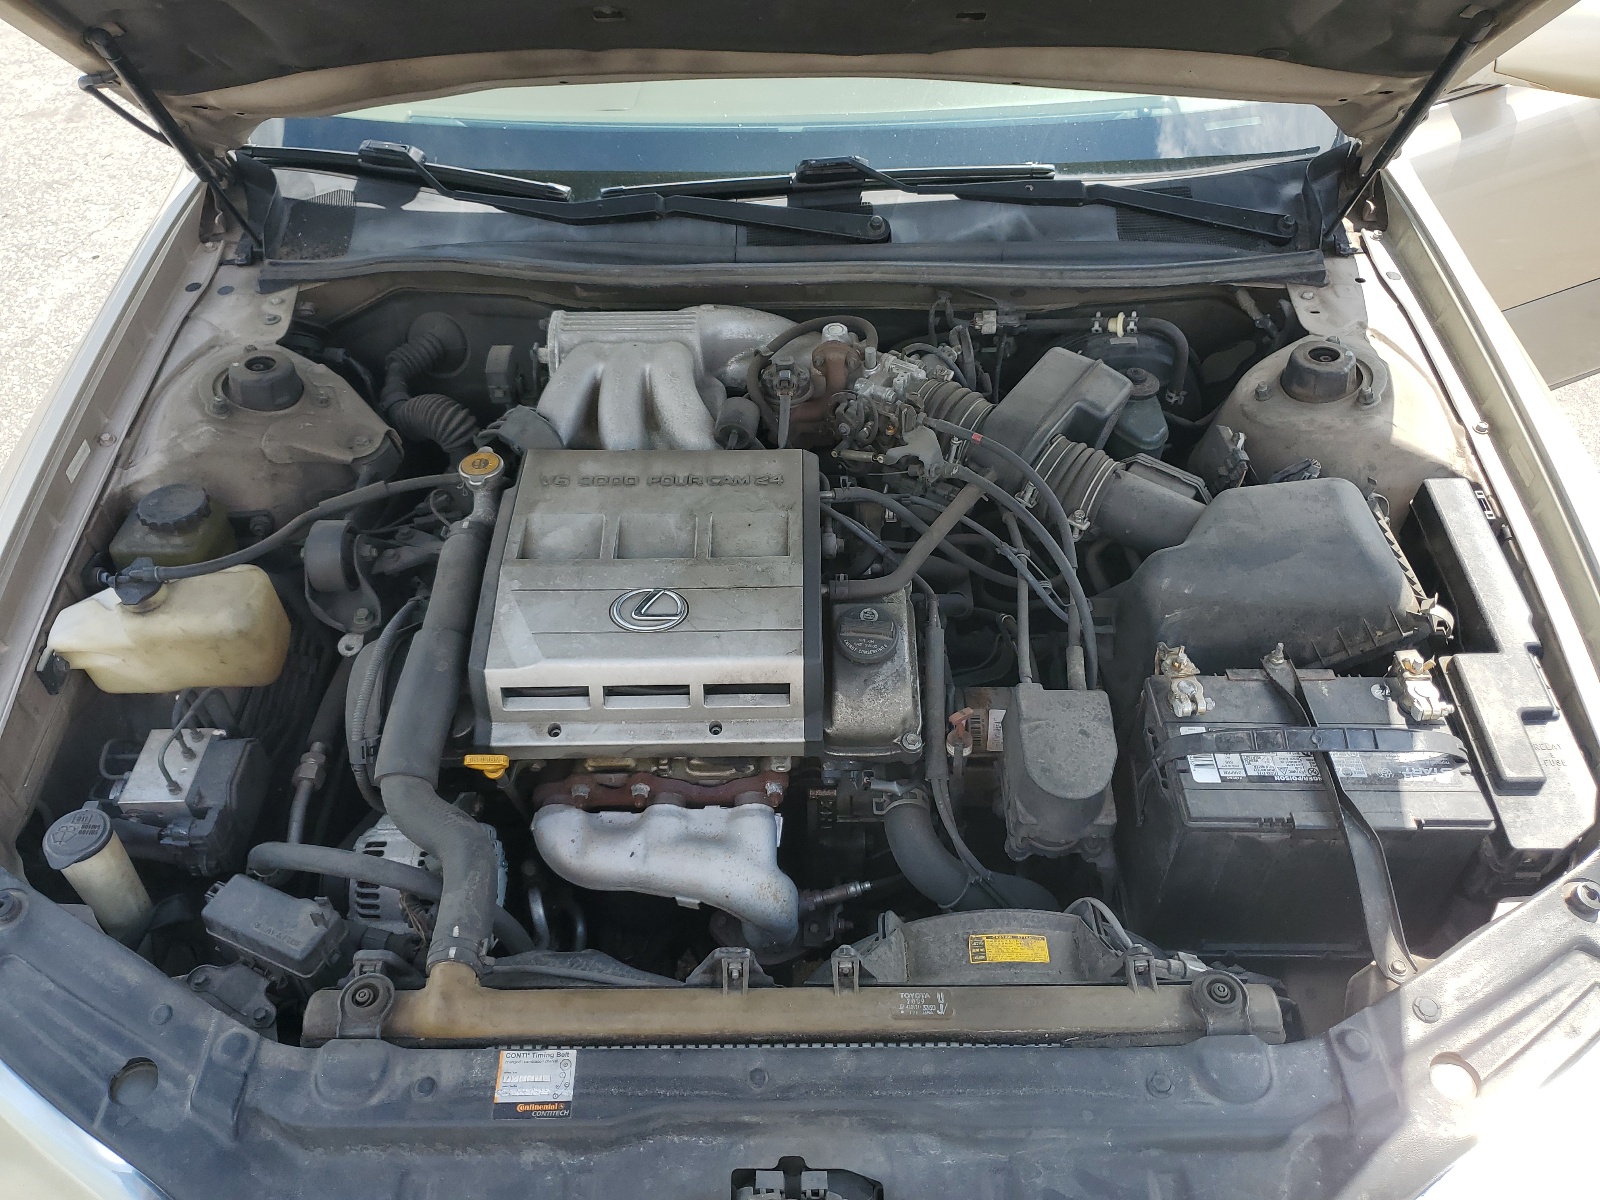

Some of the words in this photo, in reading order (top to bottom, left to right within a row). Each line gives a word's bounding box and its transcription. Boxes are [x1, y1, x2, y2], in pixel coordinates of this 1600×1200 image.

[647, 474, 703, 487] FOUR
[707, 474, 750, 487] CAM
[754, 474, 785, 487] 24
[532, 1052, 555, 1060] Timing
[516, 1103, 558, 1113] Continental
[531, 1109, 570, 1117] CONTITECH
